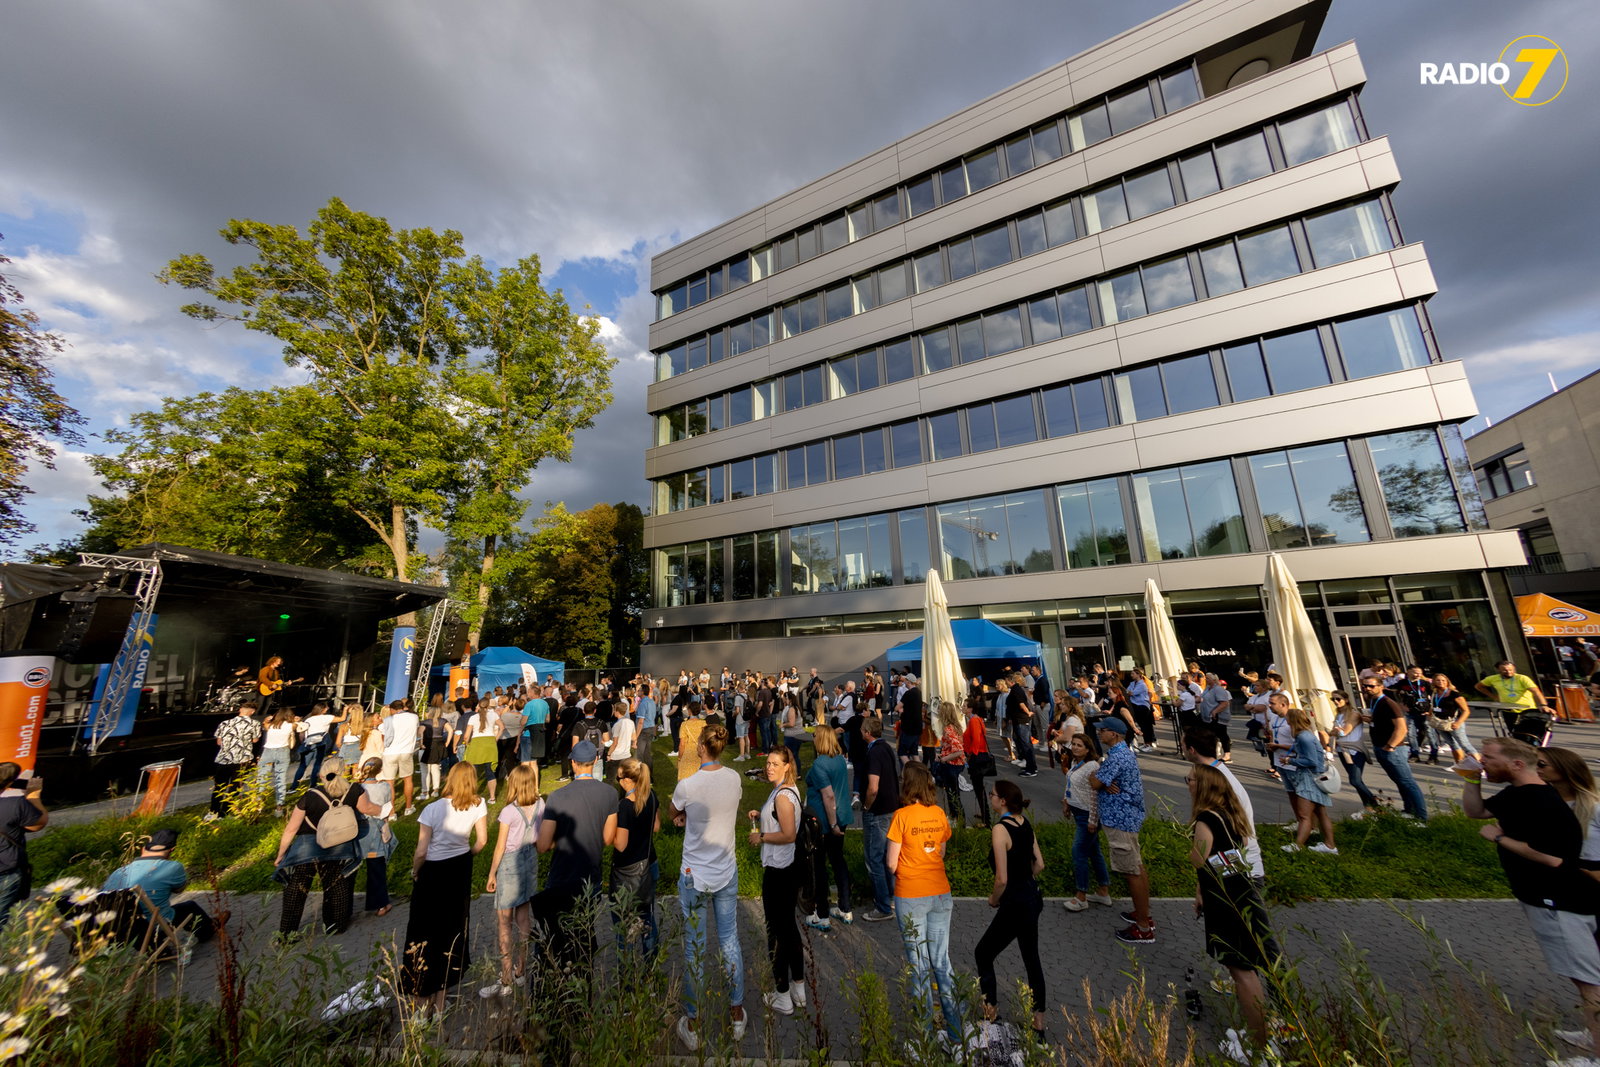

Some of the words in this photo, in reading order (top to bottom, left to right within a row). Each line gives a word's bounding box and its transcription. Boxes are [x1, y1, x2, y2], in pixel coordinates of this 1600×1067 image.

[133, 649, 150, 689] RADIO
[404, 650, 414, 676] RADIO
[15, 695, 41, 758] bbu01.com
